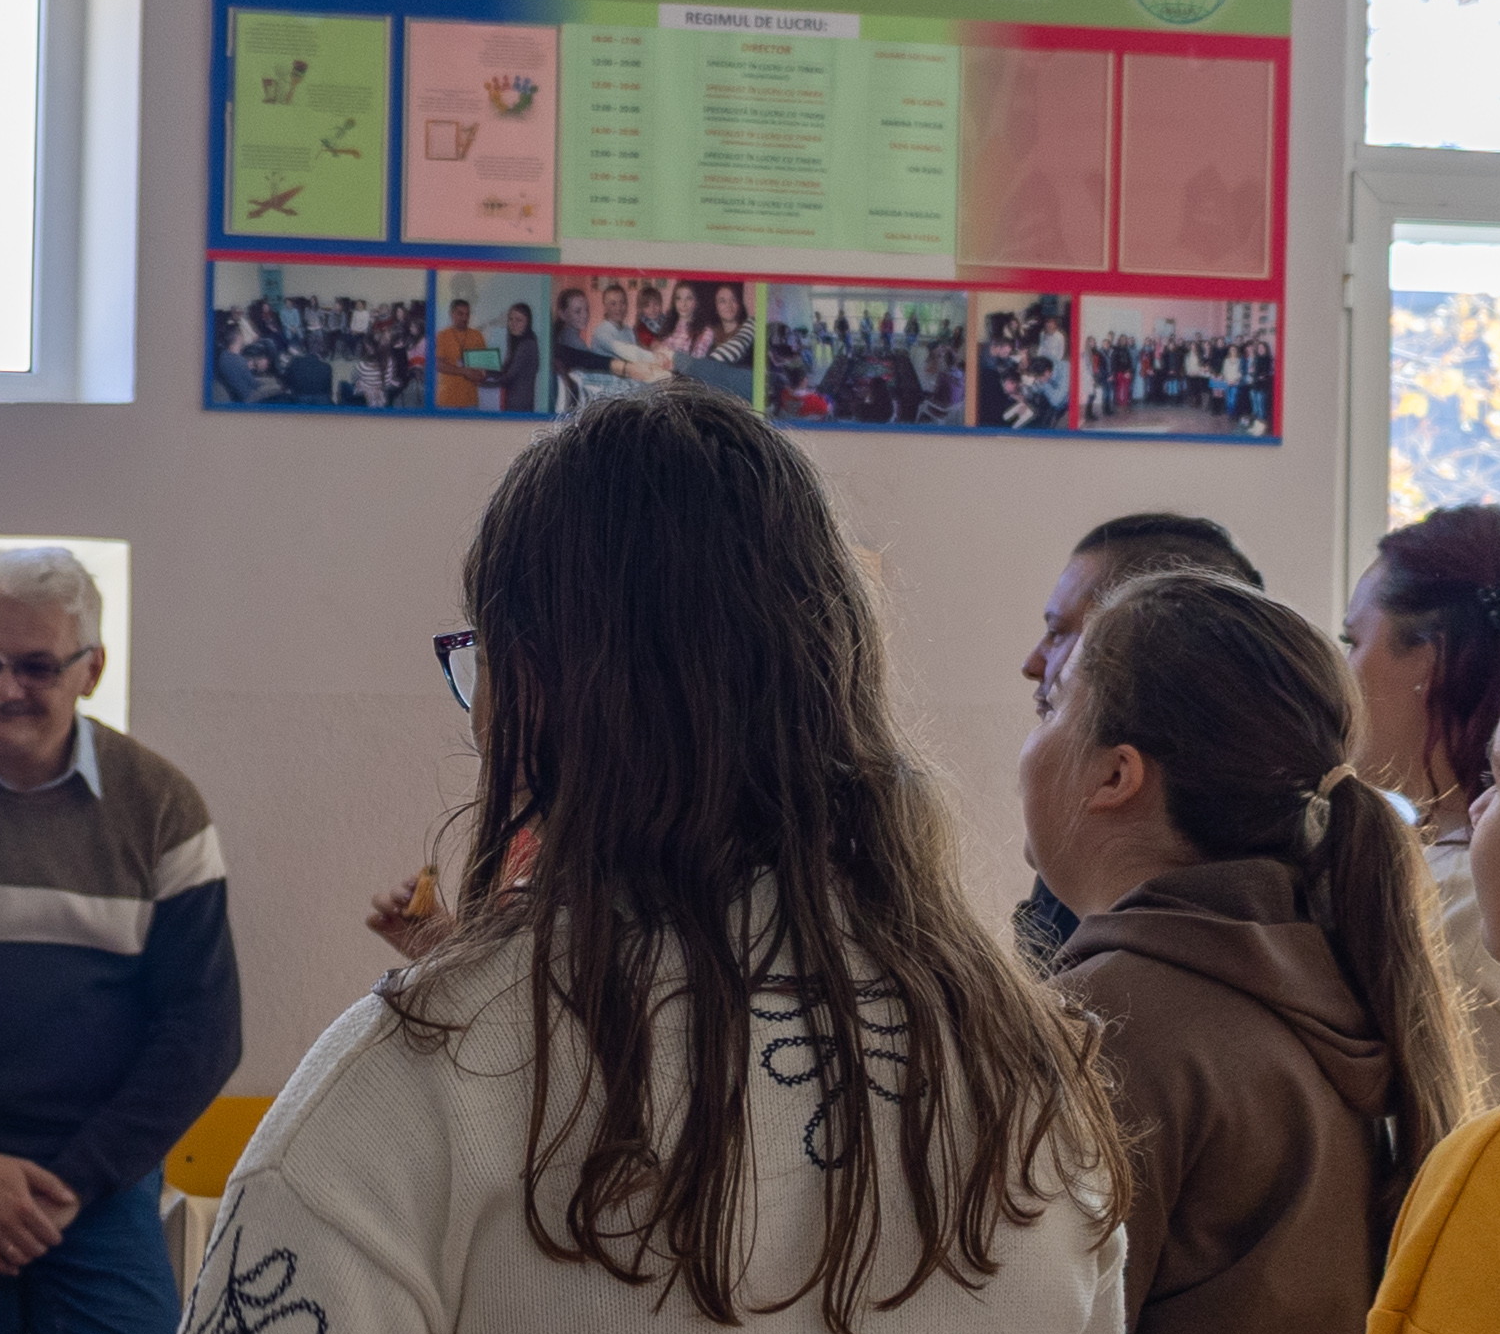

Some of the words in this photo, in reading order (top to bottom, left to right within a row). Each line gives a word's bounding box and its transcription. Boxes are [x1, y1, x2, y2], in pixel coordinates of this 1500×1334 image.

[685, 11, 750, 28] REGIMUL
[754, 15, 774, 29] DE
[776, 17, 828, 33] LUCRU:
[741, 43, 793, 56] DIRECTOR
